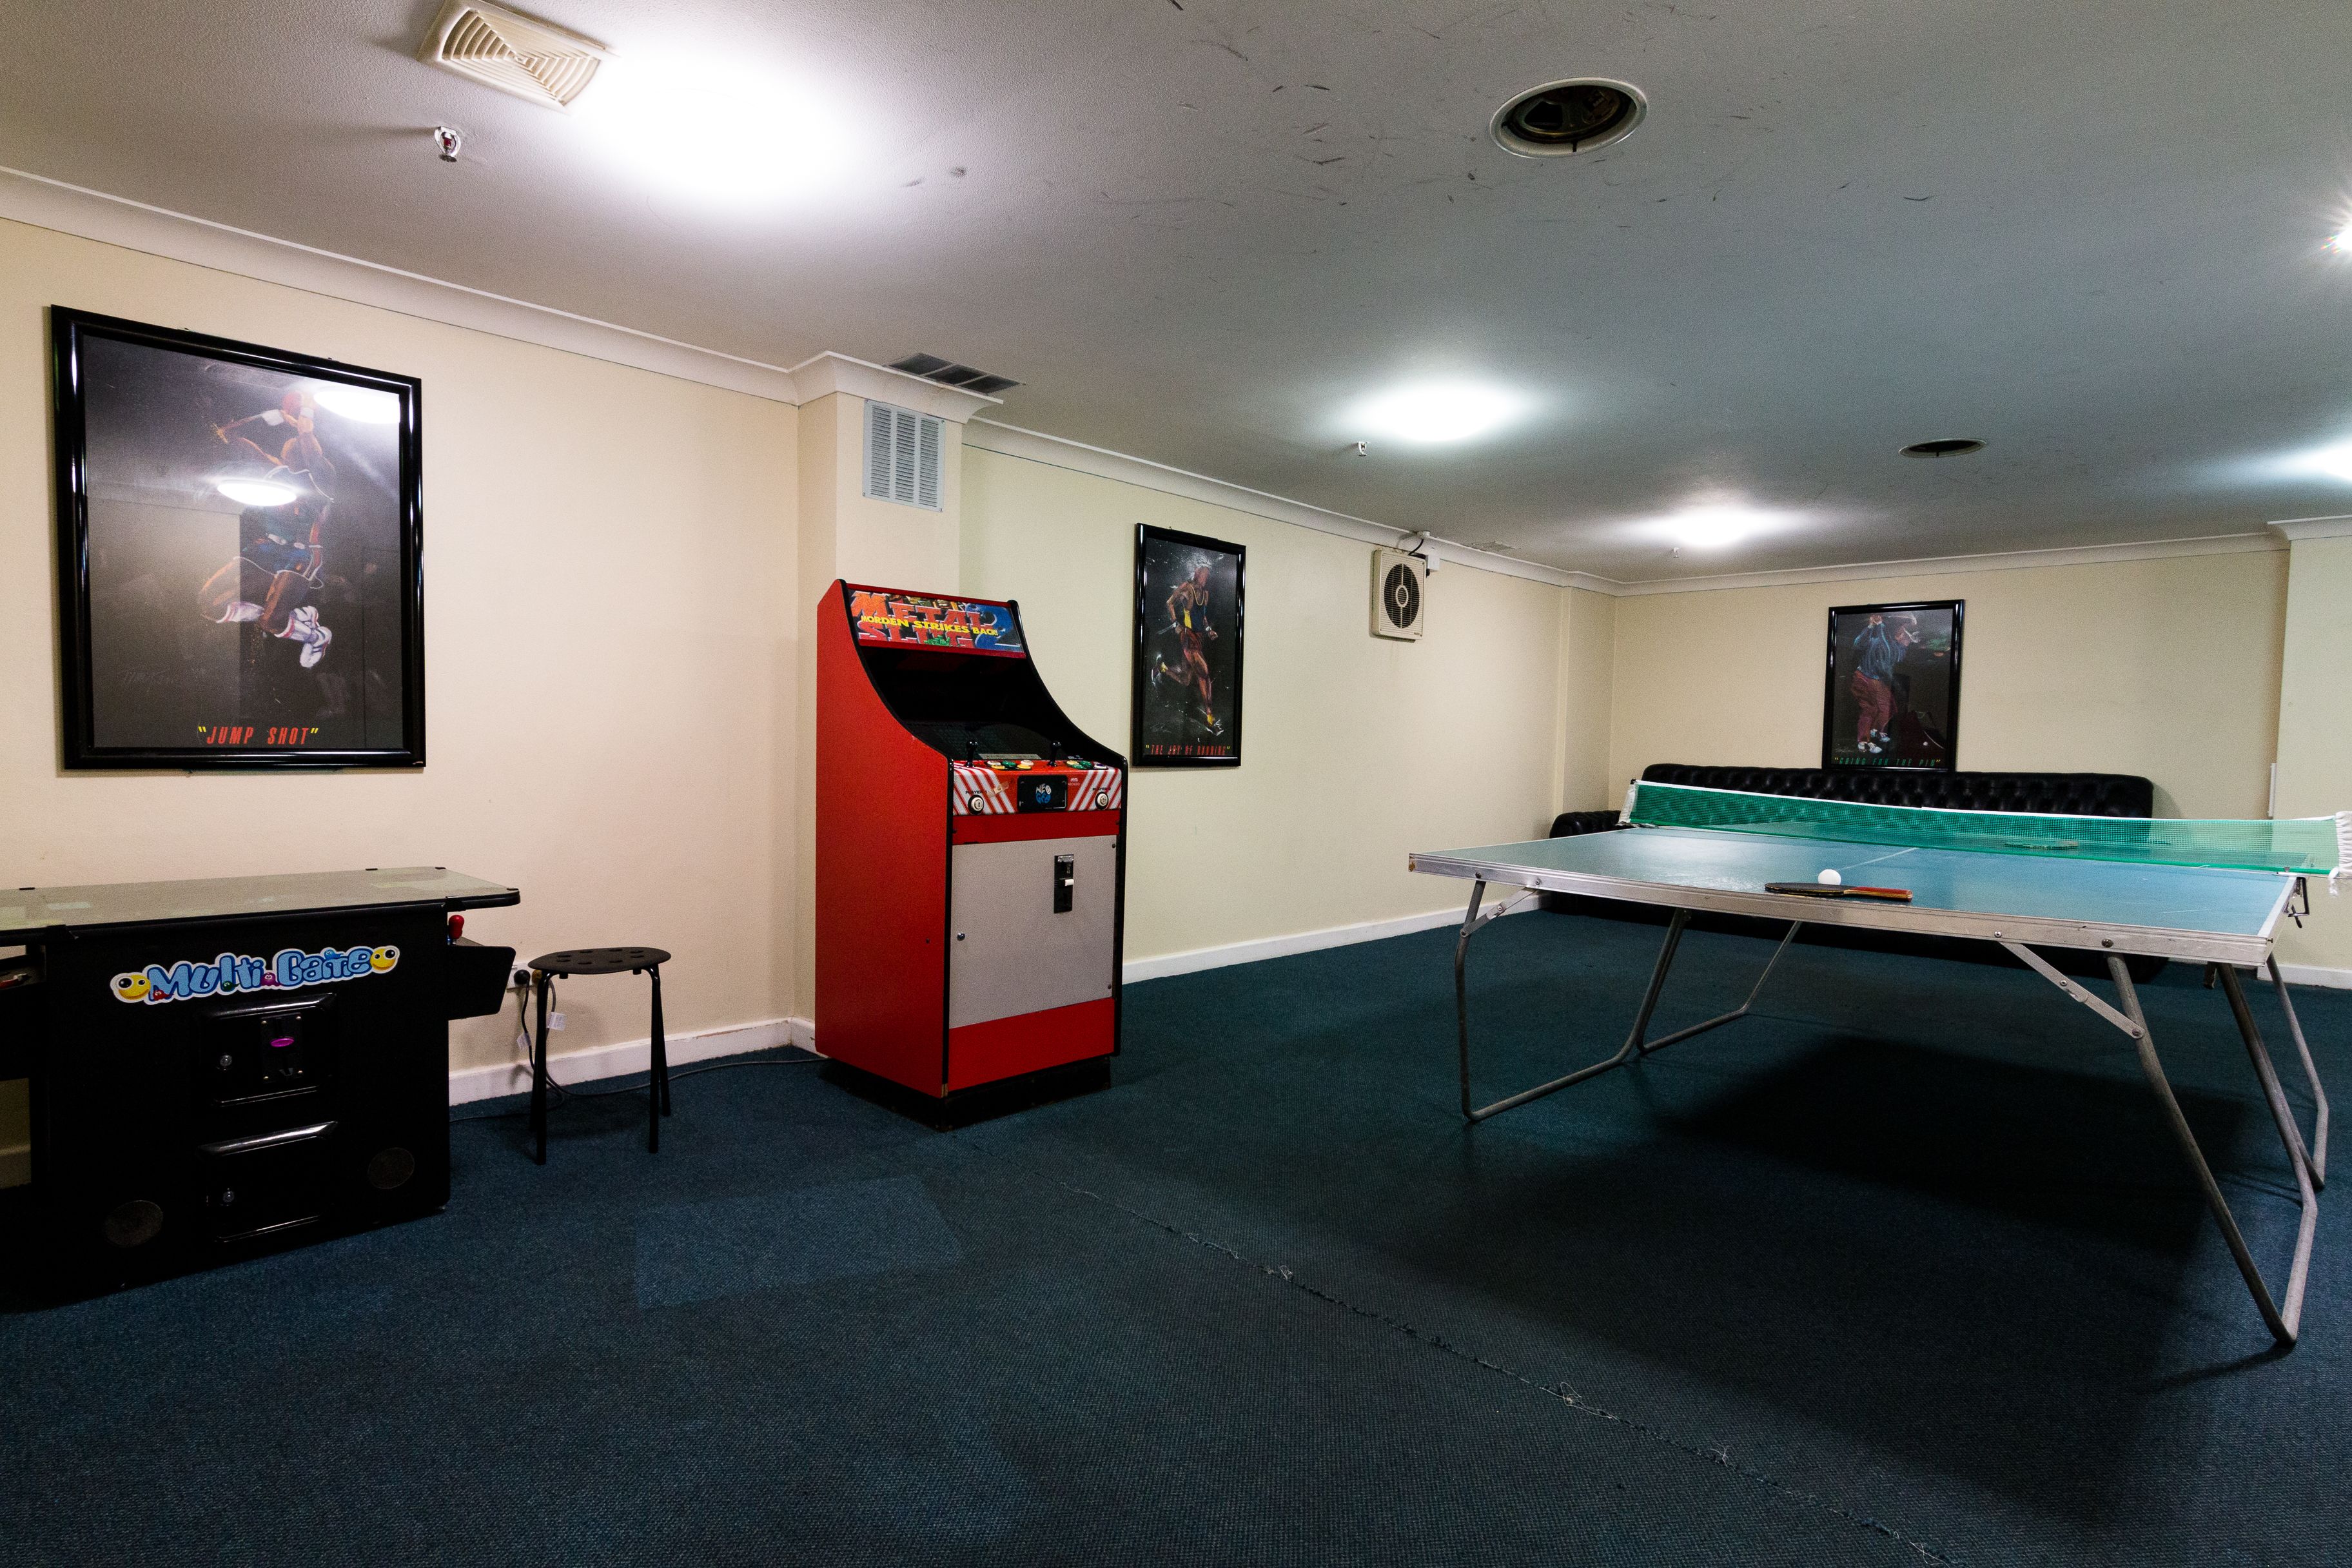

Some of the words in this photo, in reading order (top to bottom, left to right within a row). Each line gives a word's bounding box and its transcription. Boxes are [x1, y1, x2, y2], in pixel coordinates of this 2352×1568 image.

[850, 590, 994, 629] METAL
[861, 615, 909, 627] MORDEN
[913, 621, 970, 634] STRIKES
[972, 627, 998, 636] BACK!
[1035, 783, 1052, 795] NEO
[144, 952, 265, 1002] Multi
[275, 948, 373, 985] Game
